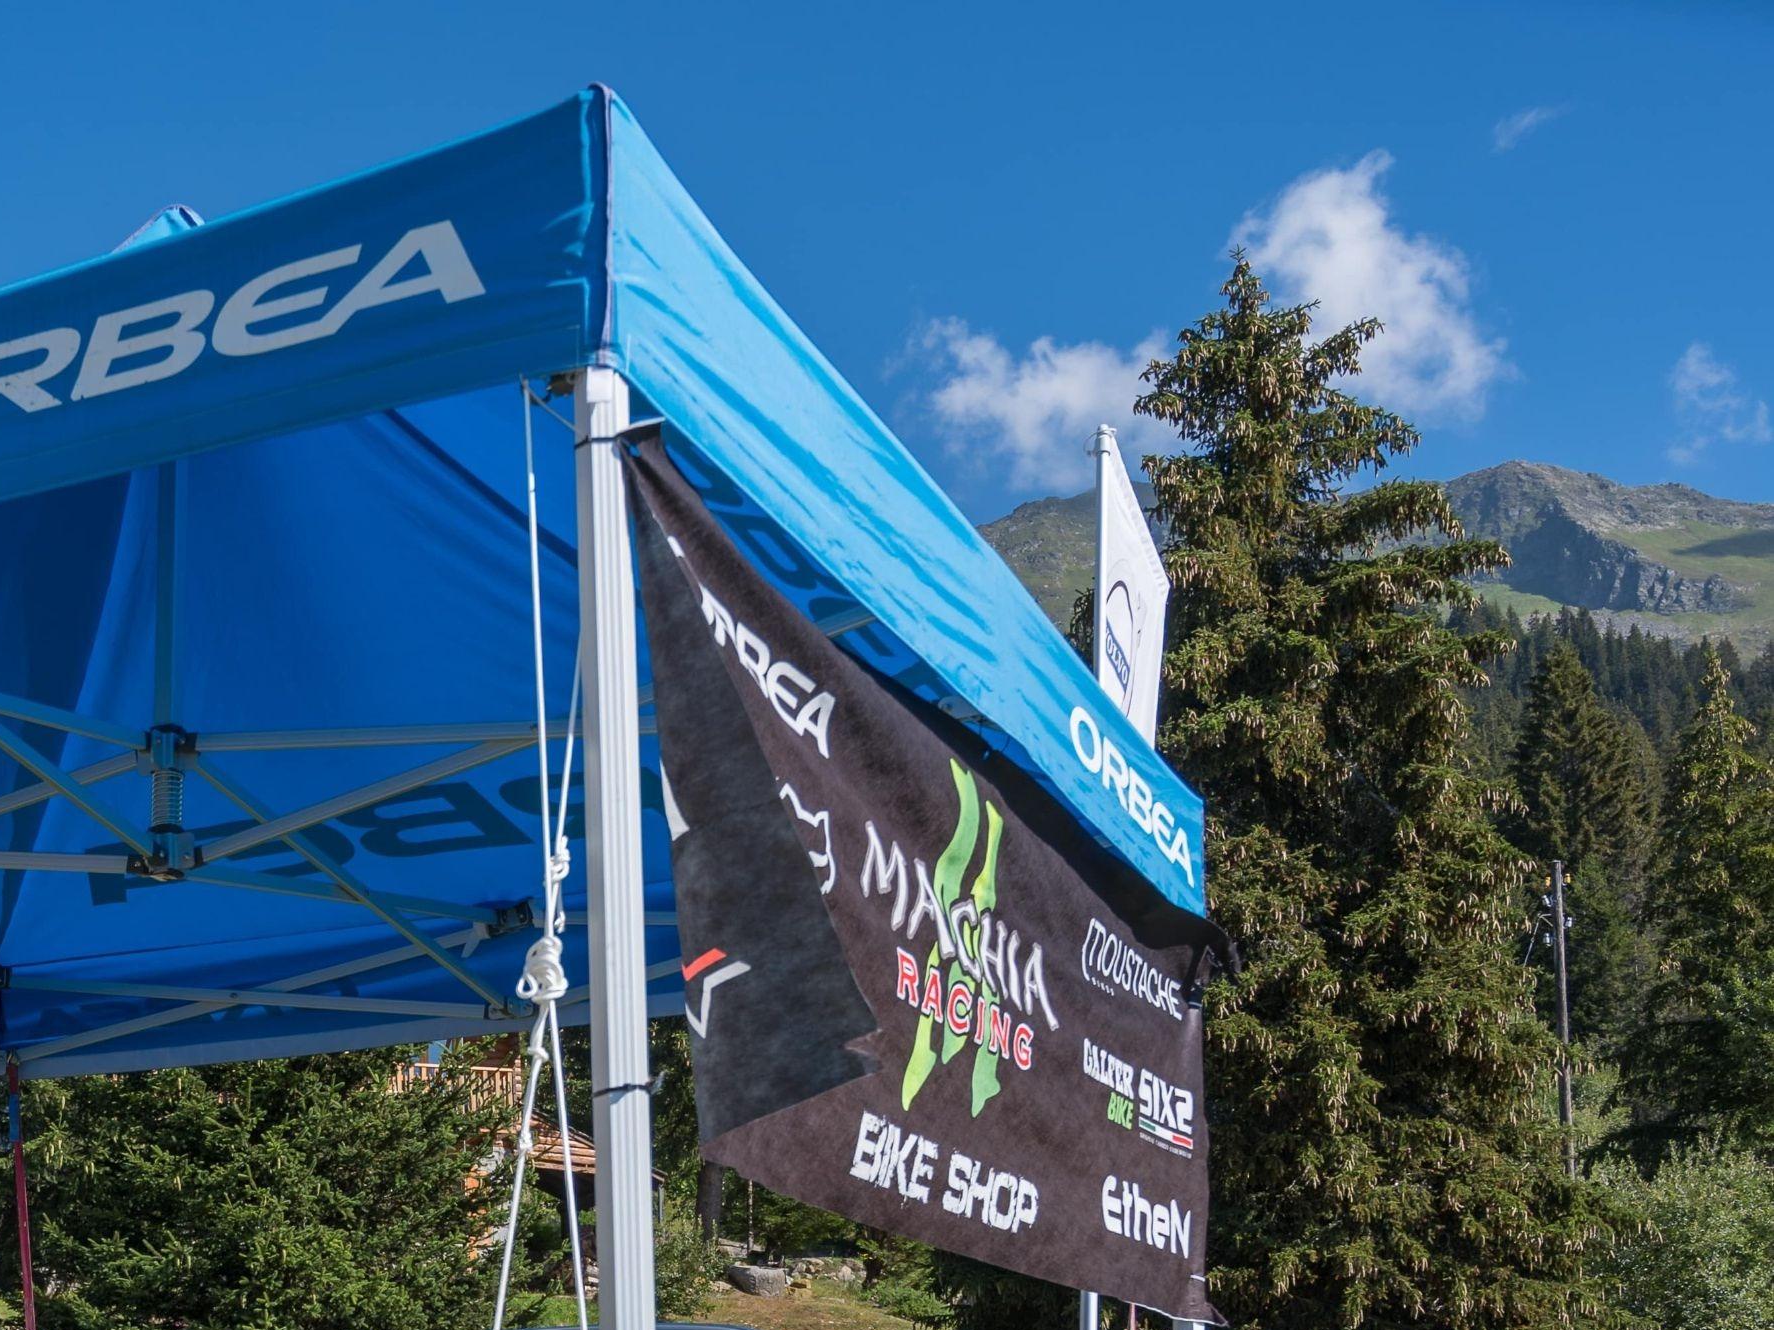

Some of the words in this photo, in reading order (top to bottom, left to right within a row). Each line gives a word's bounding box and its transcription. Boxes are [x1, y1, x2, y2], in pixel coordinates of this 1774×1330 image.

[1069, 706, 1195, 888] ORBEA
[860, 820, 1059, 1031] MACHIA
[896, 946, 1034, 1070] RACING
[1107, 1092, 1134, 1130] BIKE
[1138, 1068, 1194, 1135] SIX2
[849, 1110, 939, 1206] BIKE
[942, 1147, 1039, 1234] SHOP
